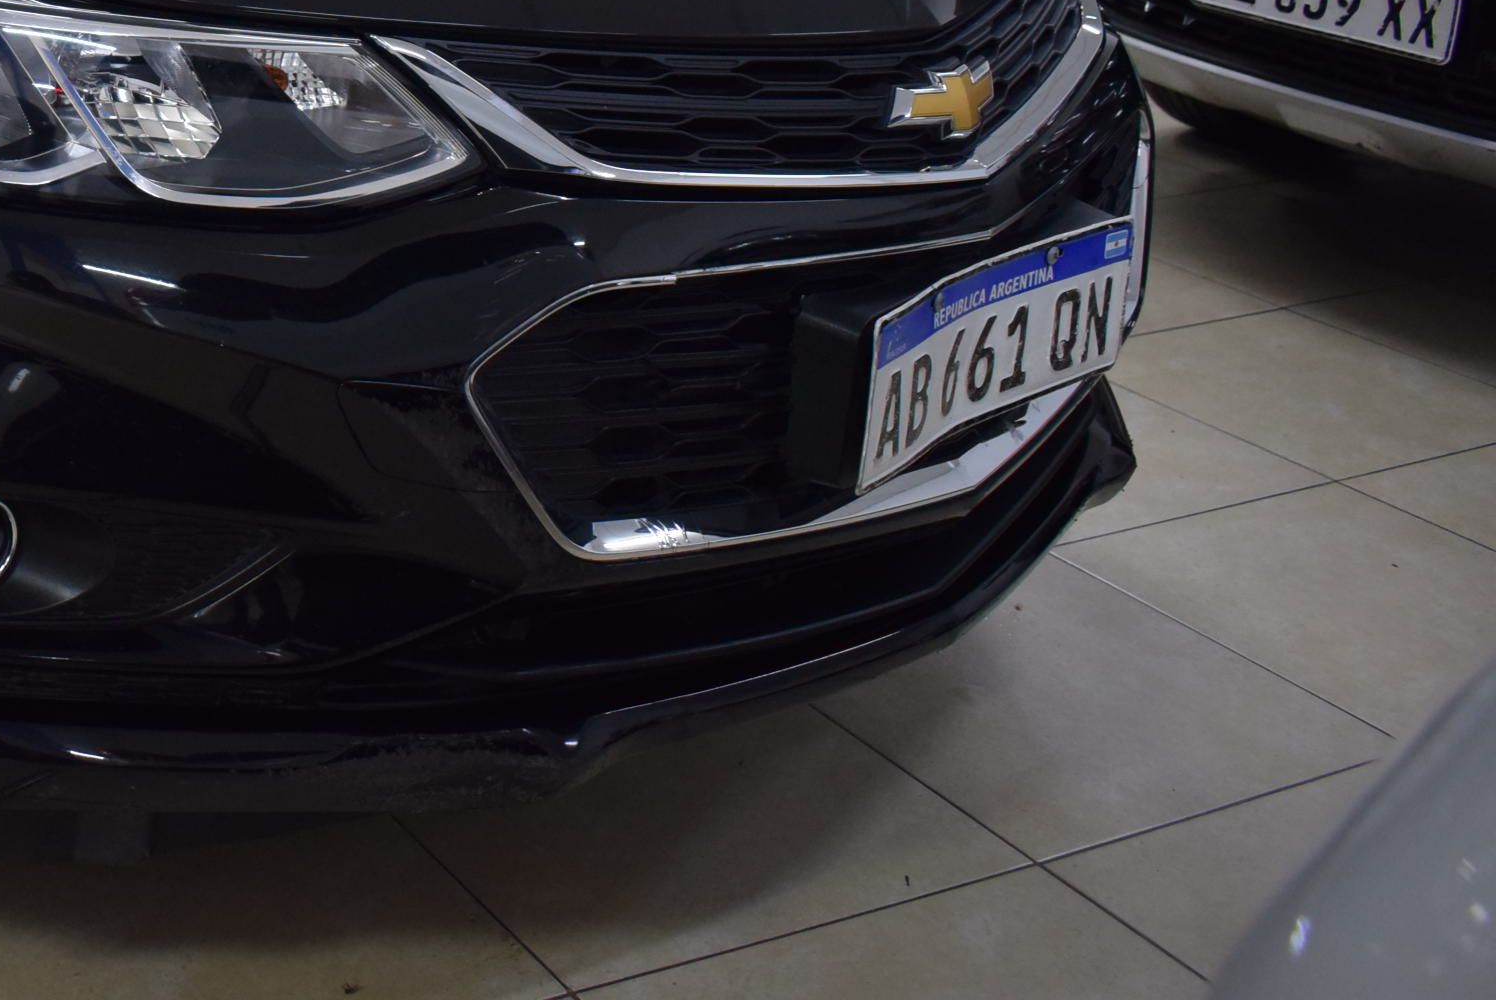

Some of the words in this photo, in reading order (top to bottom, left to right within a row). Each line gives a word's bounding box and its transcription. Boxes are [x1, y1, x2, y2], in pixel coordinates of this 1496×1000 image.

[989, 265, 1054, 301] ARGENTINA
[875, 353, 933, 460] AB
[941, 304, 1030, 418] 661
[1050, 276, 1114, 372] QN
